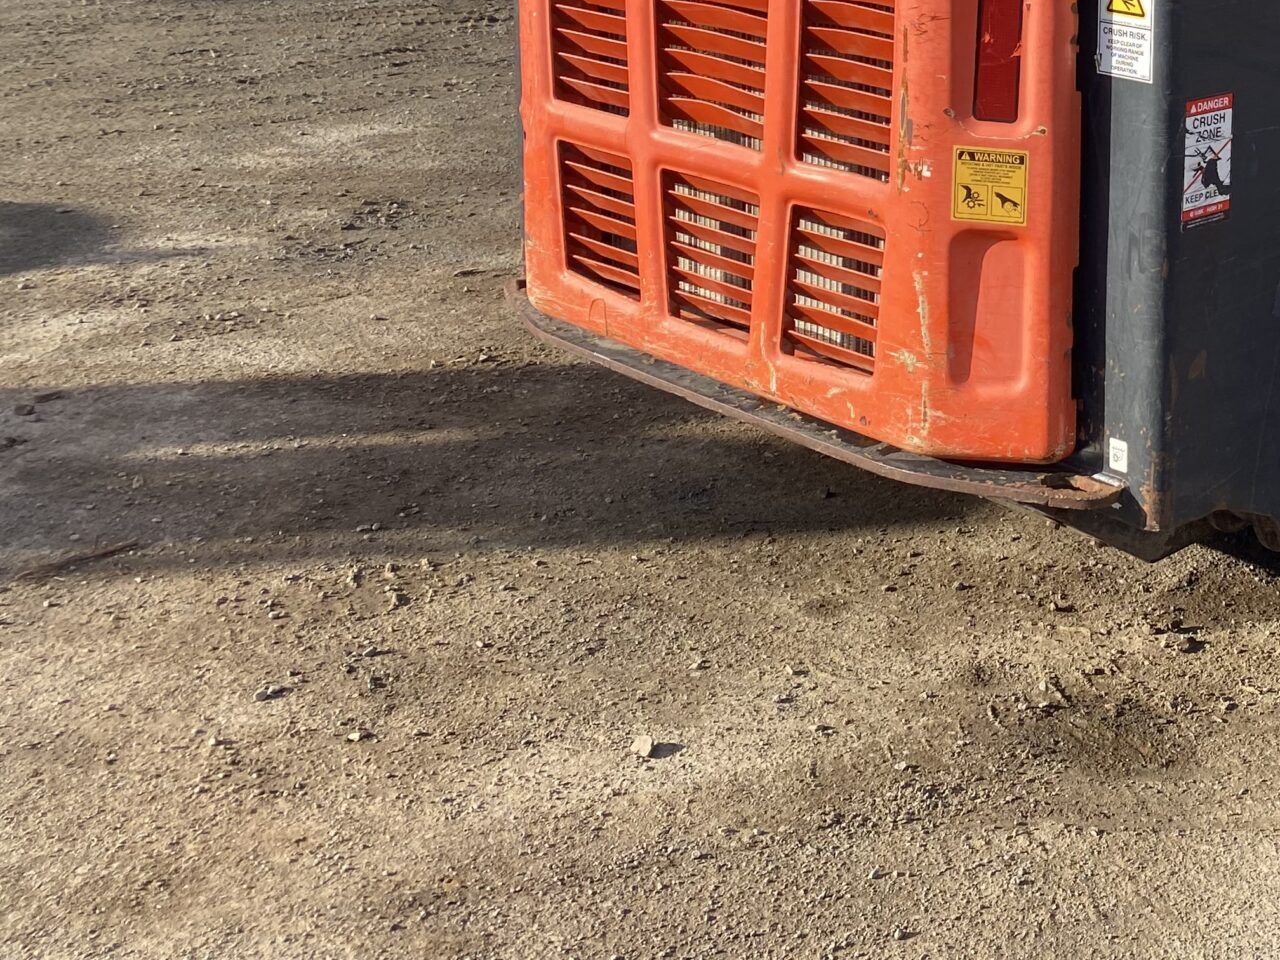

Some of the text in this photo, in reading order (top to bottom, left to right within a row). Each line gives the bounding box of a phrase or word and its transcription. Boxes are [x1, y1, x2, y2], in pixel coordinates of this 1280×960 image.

[1102, 26, 1128, 38] CRUSH
[1106, 44, 1128, 53] WORKING
[1108, 38, 1120, 46] KEEP
[1120, 40, 1136, 48] CLEAR
[1118, 53, 1139, 62] MACHINE
[1197, 96, 1229, 112] DANGER
[1192, 111, 1226, 130] CRUSH
[1195, 126, 1222, 143] ZONE
[974, 152, 1020, 164] WARNING
[1185, 189, 1219, 205] KEEP CLE
